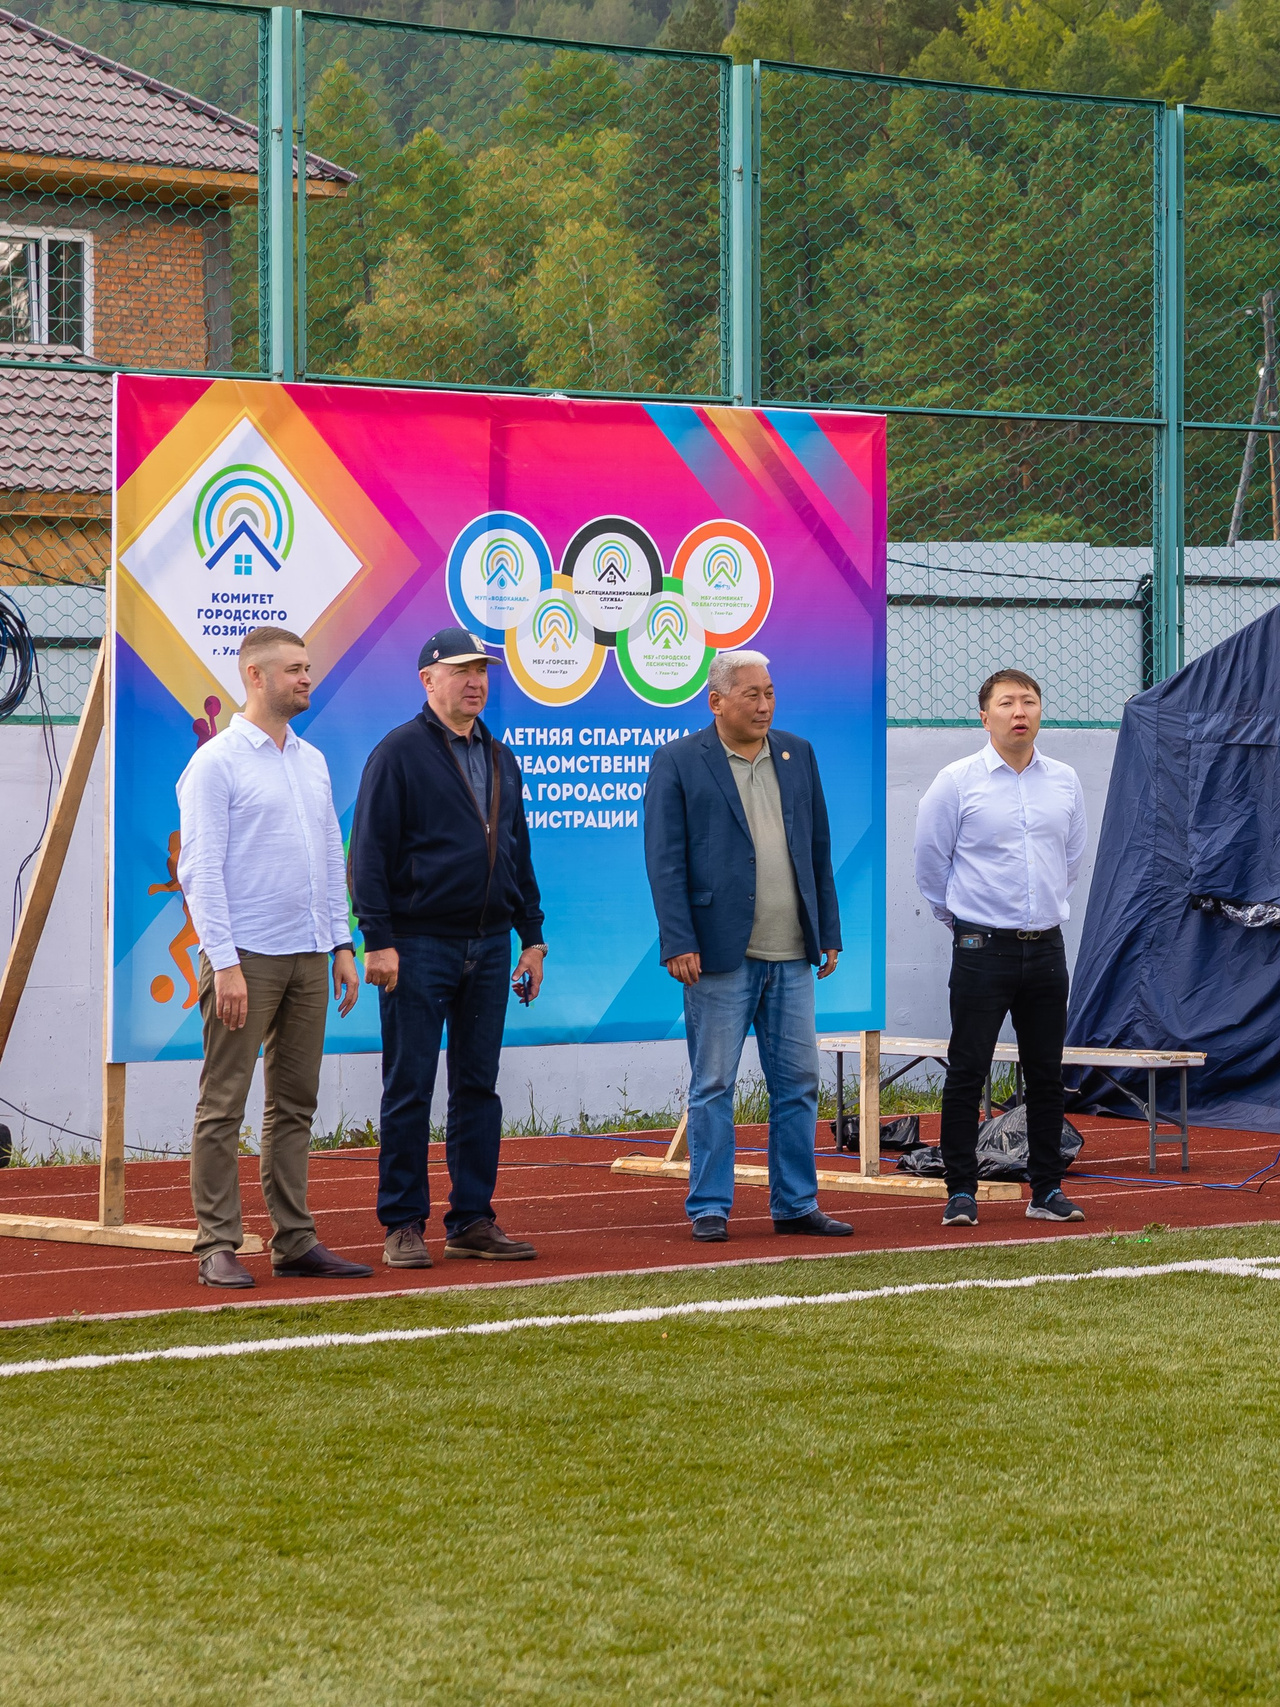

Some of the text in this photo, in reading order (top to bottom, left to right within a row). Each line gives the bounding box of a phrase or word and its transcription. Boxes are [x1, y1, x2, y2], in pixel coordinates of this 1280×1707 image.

[211, 592, 274, 605] КОМИТЕТ
[197, 608, 287, 621] ГОРОДСКОГО
[202, 622, 258, 636] ХОЗЯЙС
[212, 648, 220, 656] г.
[501, 727, 573, 746] ЛЕТНЯЯ
